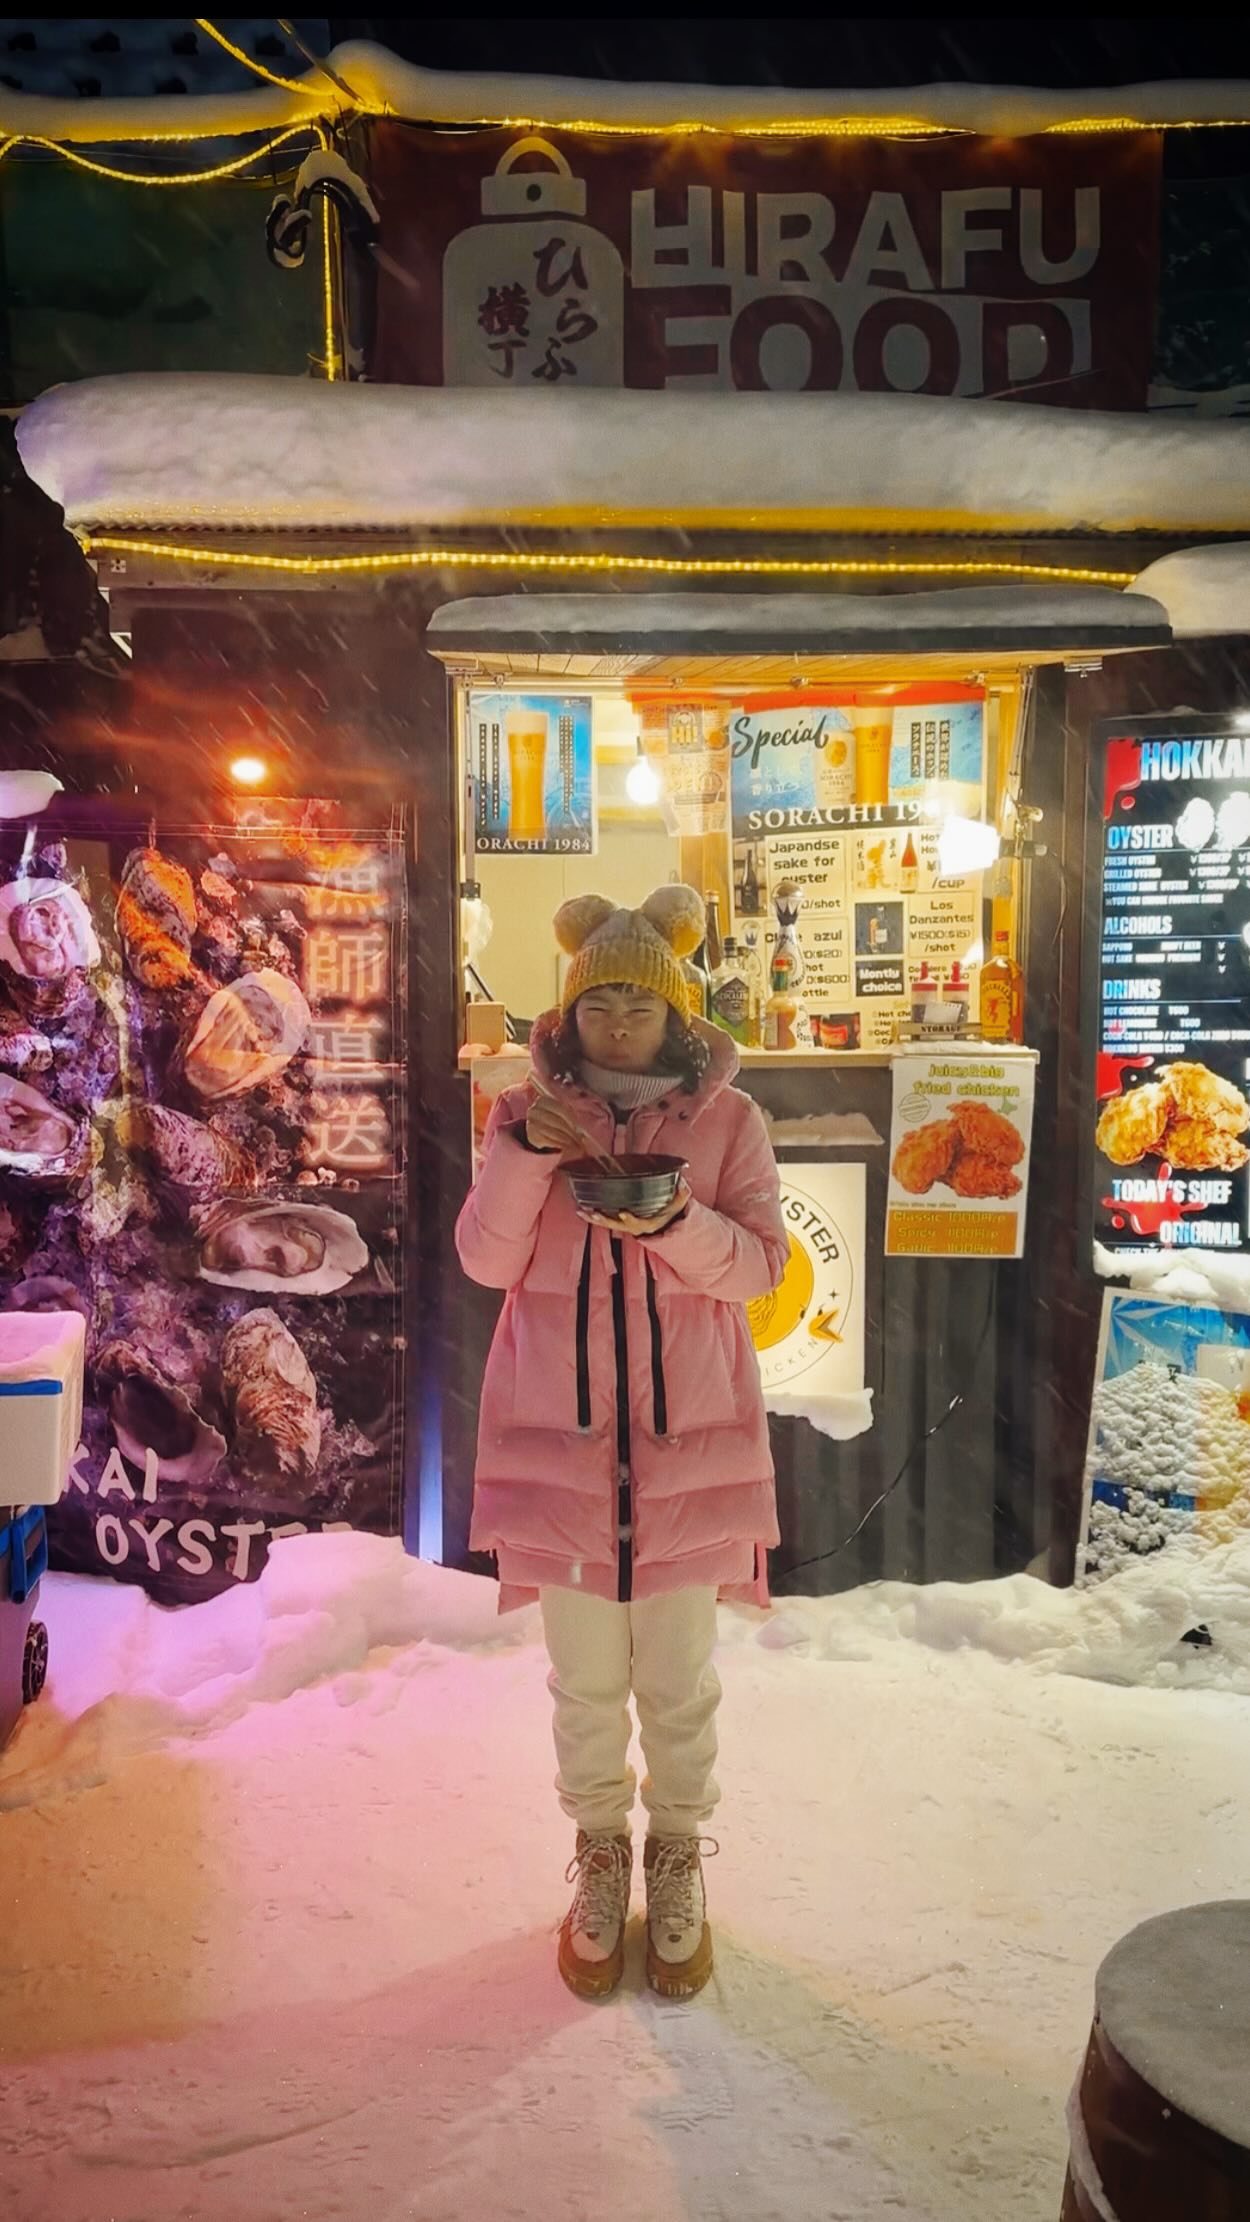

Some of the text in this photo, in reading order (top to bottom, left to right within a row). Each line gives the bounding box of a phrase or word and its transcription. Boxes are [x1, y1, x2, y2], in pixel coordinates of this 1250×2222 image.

[631, 185, 1100, 290] HIRAFU
[531, 237, 599, 381] ひらふ
[477, 282, 531, 379] 横丁
[624, 293, 1076, 398] FOOD
[731, 714, 830, 769] Special
[748, 802, 883, 830] SORACHI
[476, 837, 590, 850] ORACHI 1984
[1107, 824, 1174, 849] OYSTER
[774, 855, 835, 870] sake for
[930, 901, 953, 910] Los
[909, 914, 975, 924] Danzantes
[1104, 915, 1173, 936] ALCOHOLS
[813, 929, 843, 941] azul
[924, 943, 956, 953] /shot
[859, 968, 900, 979] Montly
[802, 989, 829, 998] ottle
[862, 981, 902, 993] choice
[1103, 979, 1161, 1000] DRINKS
[303, 862, 388, 1165] 漁師直送
[1112, 1179, 1187, 1203] TODAY'S
[781, 1196, 840, 1264] STER
[1160, 1221, 1242, 1245] ORIGINAL
[766, 1340, 819, 1376] ICKEN
[96, 1514, 354, 1581] OYST
